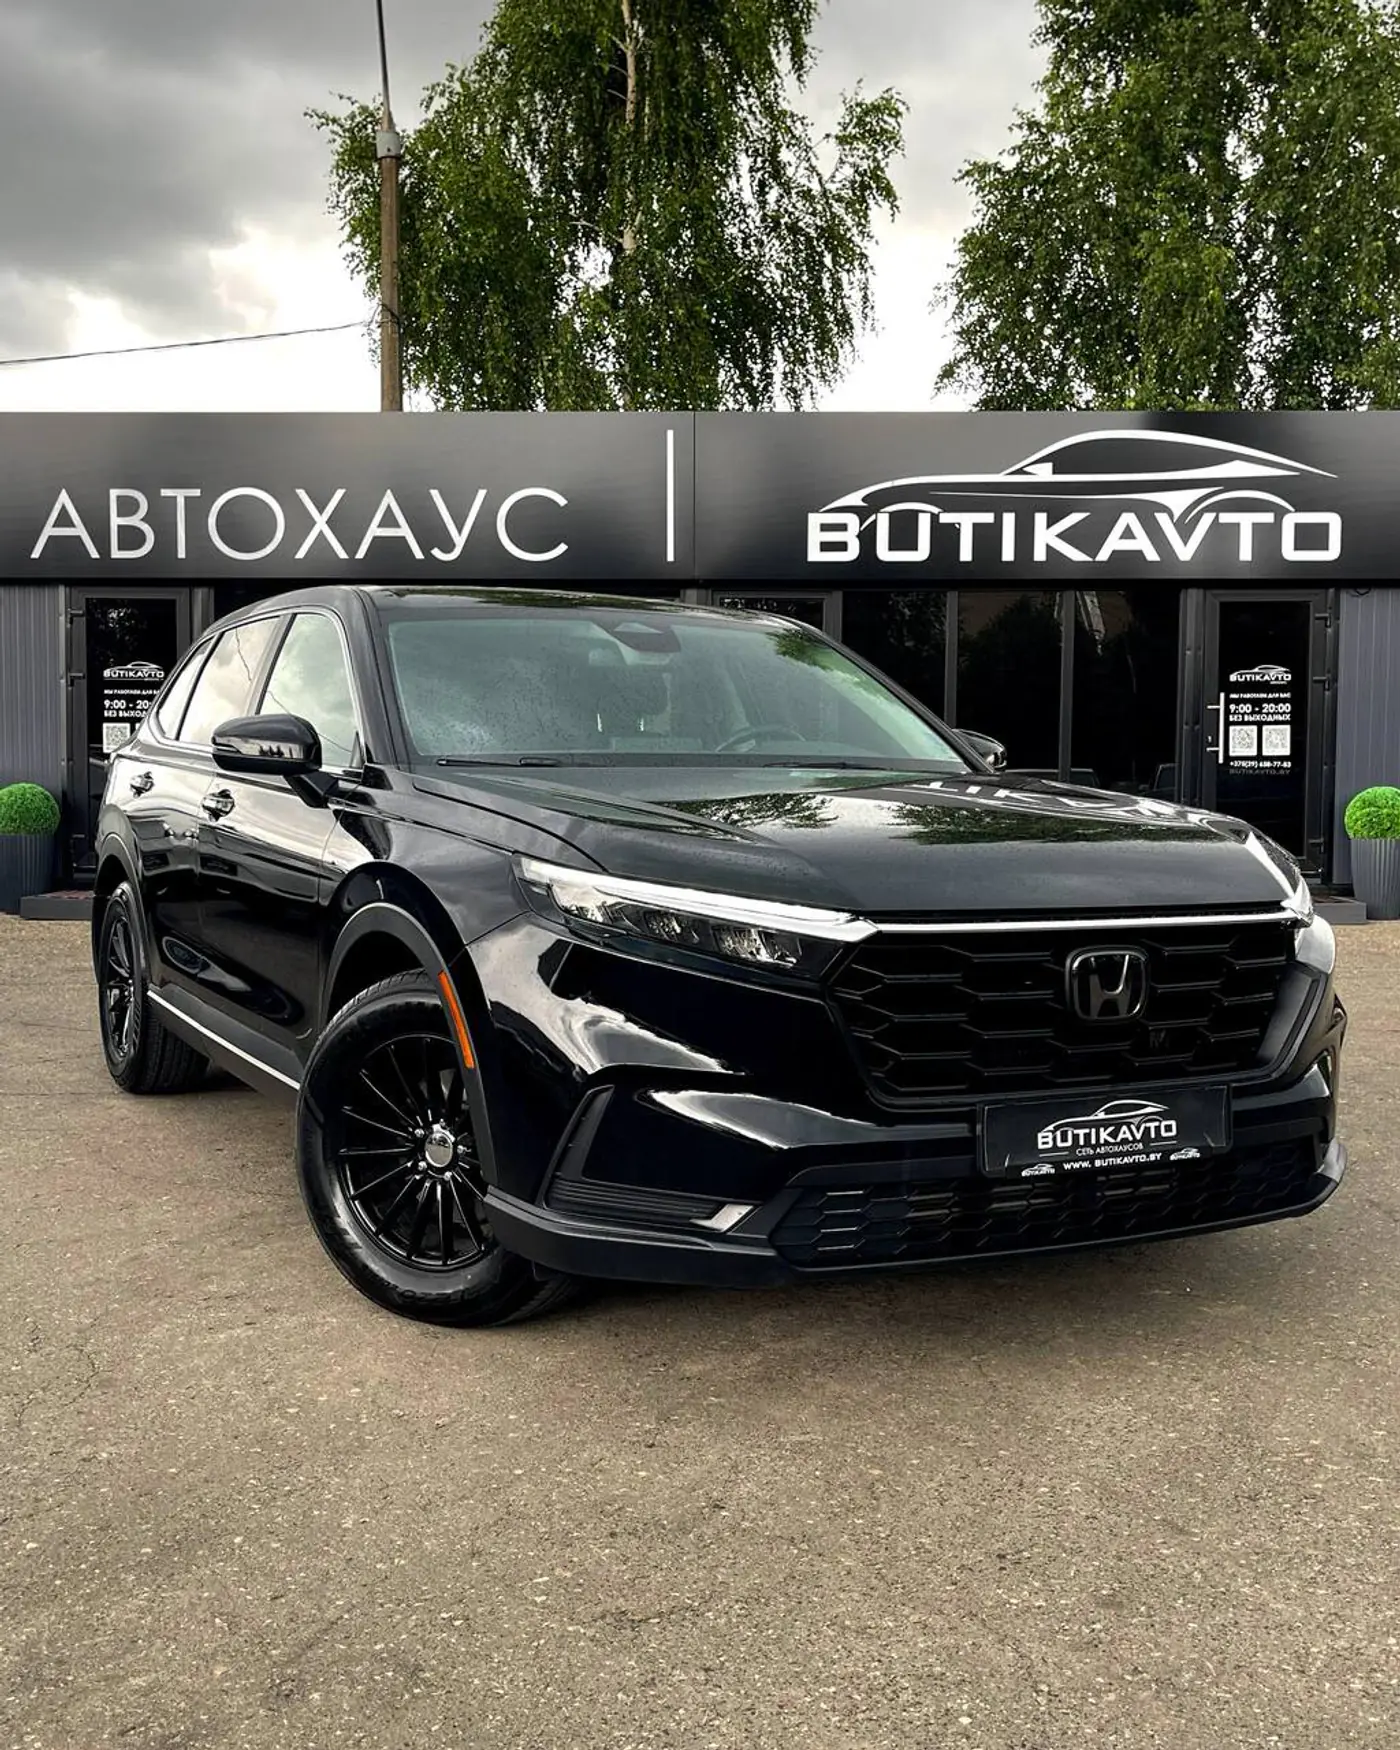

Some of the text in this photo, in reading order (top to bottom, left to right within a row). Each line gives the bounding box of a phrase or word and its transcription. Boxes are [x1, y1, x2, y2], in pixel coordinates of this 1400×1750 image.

[31, 487, 569, 562] АВТОХАУС
[807, 511, 1342, 562] BUTIKAVTO
[103, 669, 165, 678] BUTIKAVTO
[1229, 673, 1292, 682] BUTIKAVTO
[103, 699, 127, 710] 9:00
[1229, 703, 1253, 714] 9:00
[1262, 702, 1292, 713] 20:00
[103, 710, 148, 718] БЕЗ ВЫХОД
[1244, 713, 1291, 721] ВЫХОДНЫХ
[1037, 1120, 1177, 1150] BUTIKAVTO
[1075, 1142, 1144, 1157] СЕТЬ АВТОХАУСОВ
[1094, 1152, 1162, 1168] BUTIKAVTO.BY
